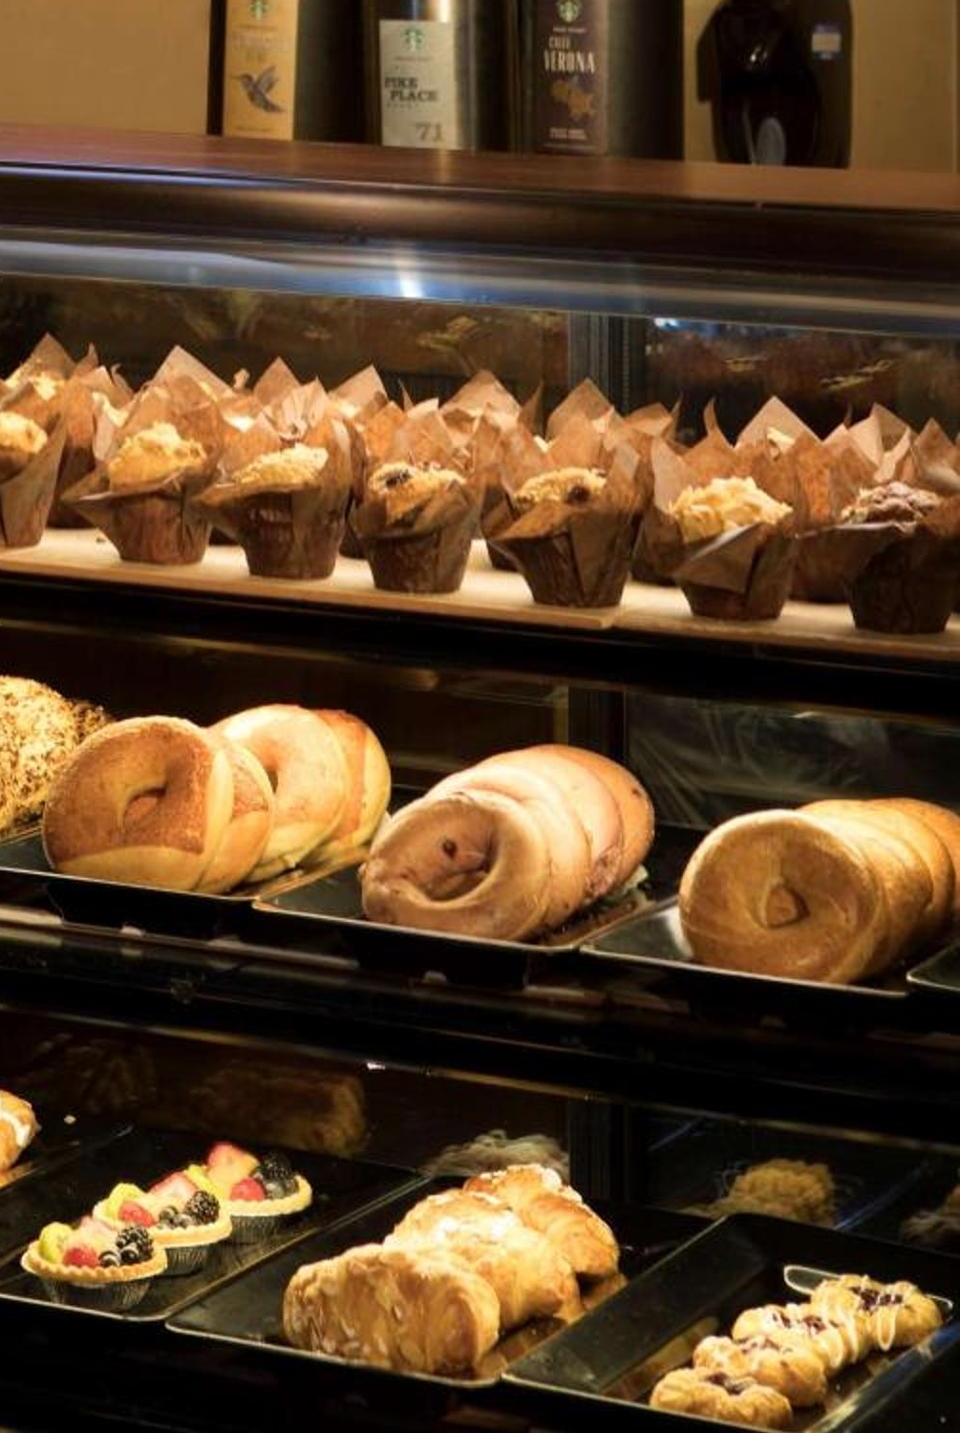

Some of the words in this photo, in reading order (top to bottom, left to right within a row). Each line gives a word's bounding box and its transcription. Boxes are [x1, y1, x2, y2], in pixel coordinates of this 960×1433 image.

[543, 48, 596, 73] VERONA
[384, 75, 419, 90] PIKE
[390, 89, 439, 103] PLACE
